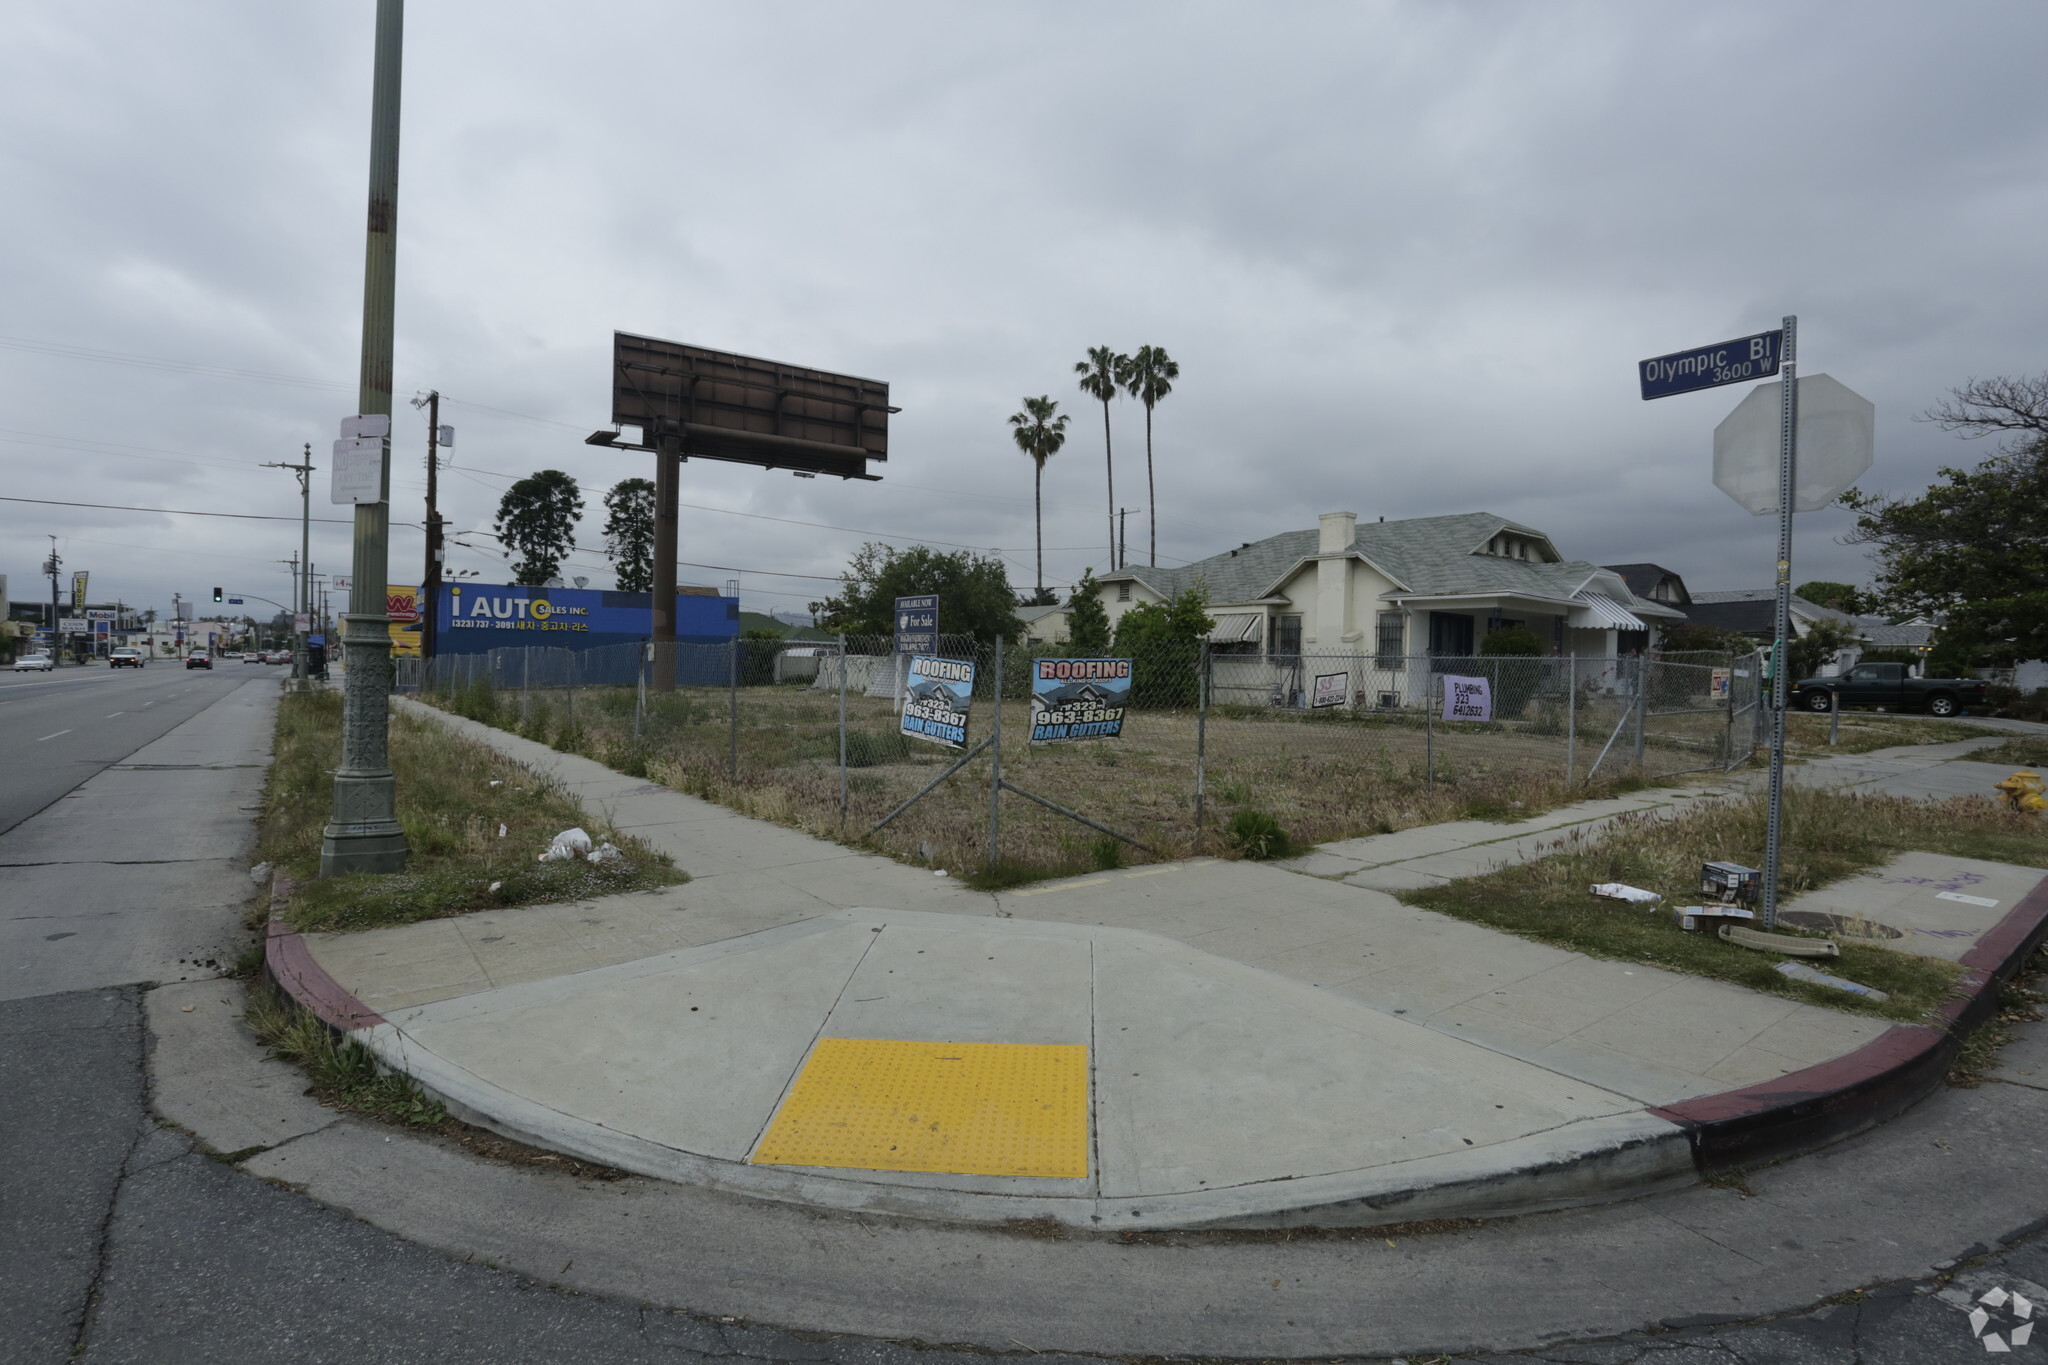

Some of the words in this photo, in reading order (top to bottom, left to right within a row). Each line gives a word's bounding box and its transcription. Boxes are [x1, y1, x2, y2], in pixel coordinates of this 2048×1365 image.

[1646, 351, 1727, 383] Olympic
[1750, 336, 1771, 360] Bl
[1712, 361, 1752, 382] 3600
[1760, 357, 1772, 373] W
[539, 605, 567, 615] SALES
[569, 607, 589, 616] INC.
[900, 599, 921, 609] AVAILABLE
[921, 598, 933, 607] NOW
[452, 619, 475, 628] (323)
[910, 615, 920, 627] For
[921, 613, 933, 627] Sale
[913, 659, 971, 682] ROOFING
[1040, 661, 1129, 678] ROOFING
[1454, 682, 1483, 696] PLUMBING
[928, 699, 945, 710] 323
[1072, 701, 1097, 711] 323
[1455, 693, 1470, 705] 323
[906, 703, 967, 727] 963-8367
[1037, 707, 1124, 725] 963-8367
[1453, 704, 1483, 717] 6412632
[904, 715, 924, 733] RAIN
[924, 719, 965, 743] GUTTERS
[1034, 724, 1068, 739] RAIN
[1070, 719, 1121, 737] GUTTERS
